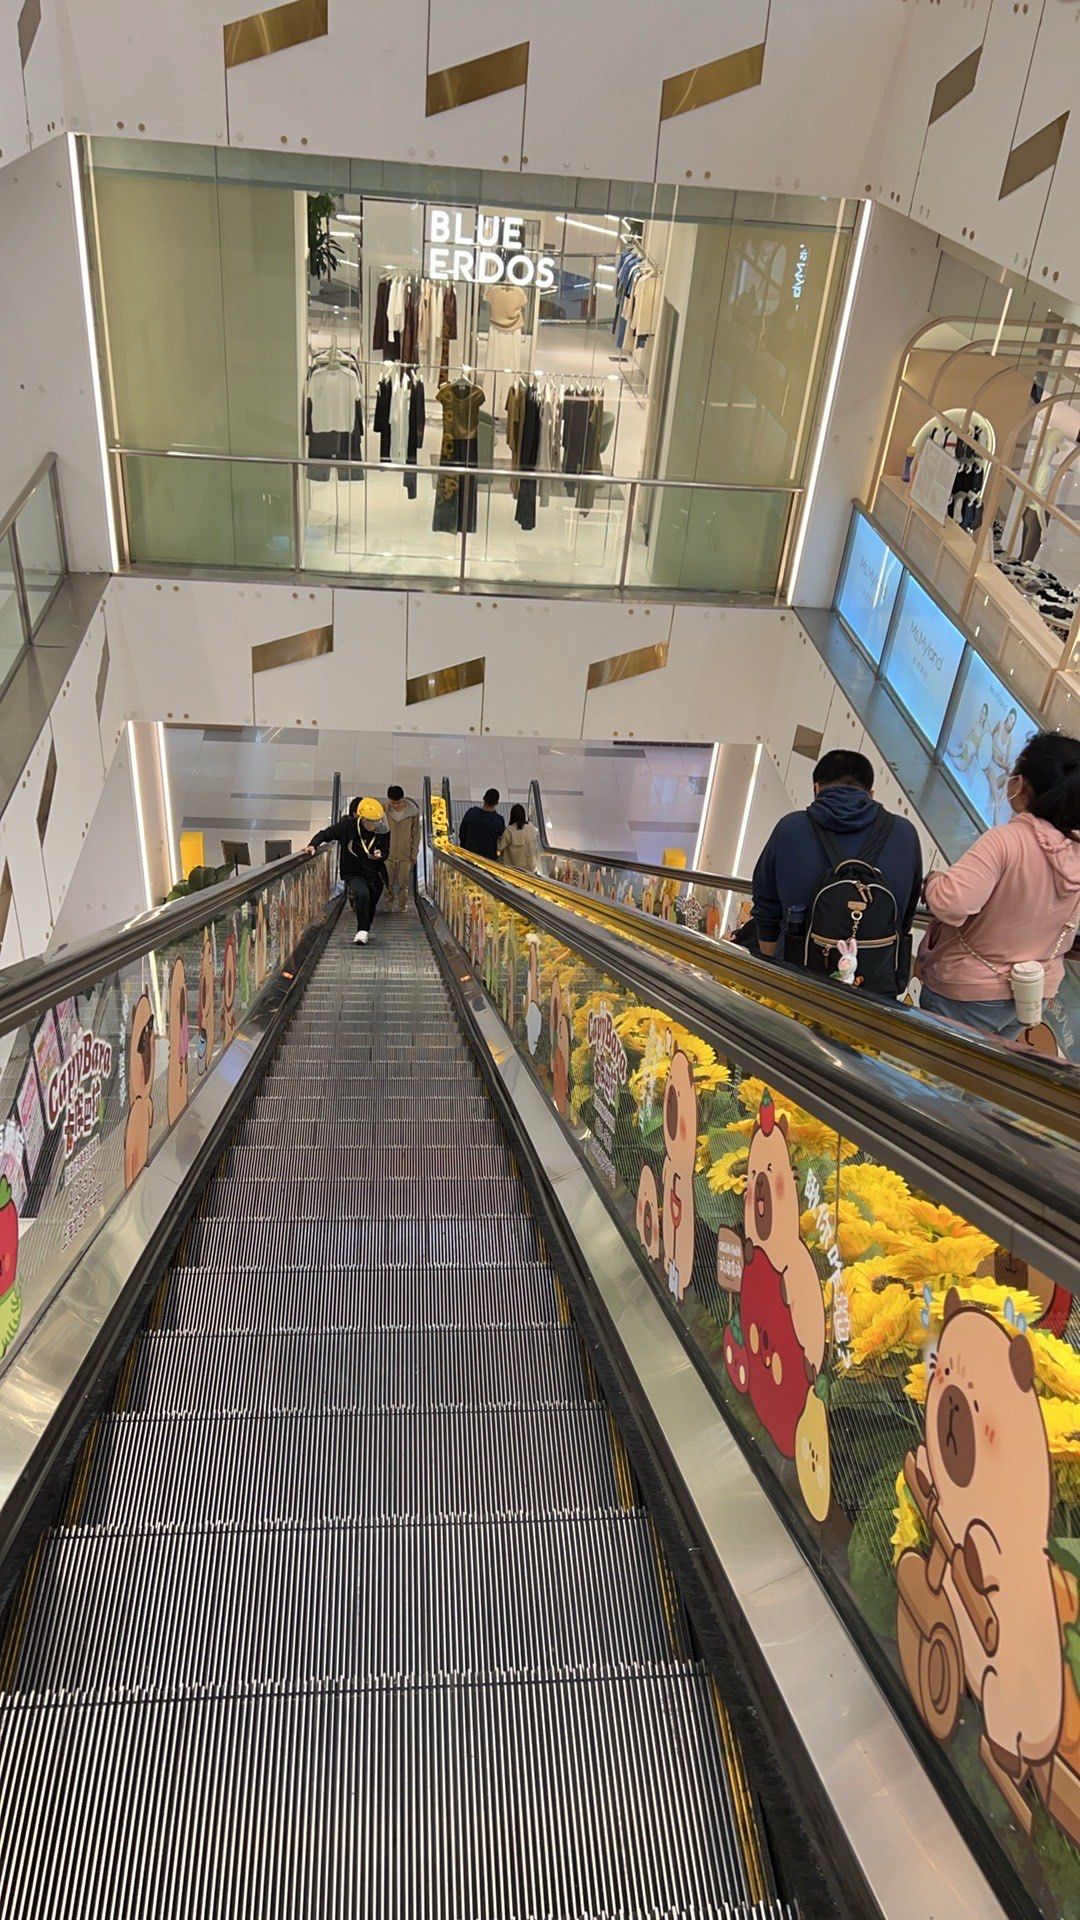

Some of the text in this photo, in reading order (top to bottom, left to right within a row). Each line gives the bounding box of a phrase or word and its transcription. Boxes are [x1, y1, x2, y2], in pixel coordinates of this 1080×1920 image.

[430, 209, 524, 250] BLUE
[429, 248, 555, 289] ERDOS
[47, 1031, 112, 1129] CapyBara
